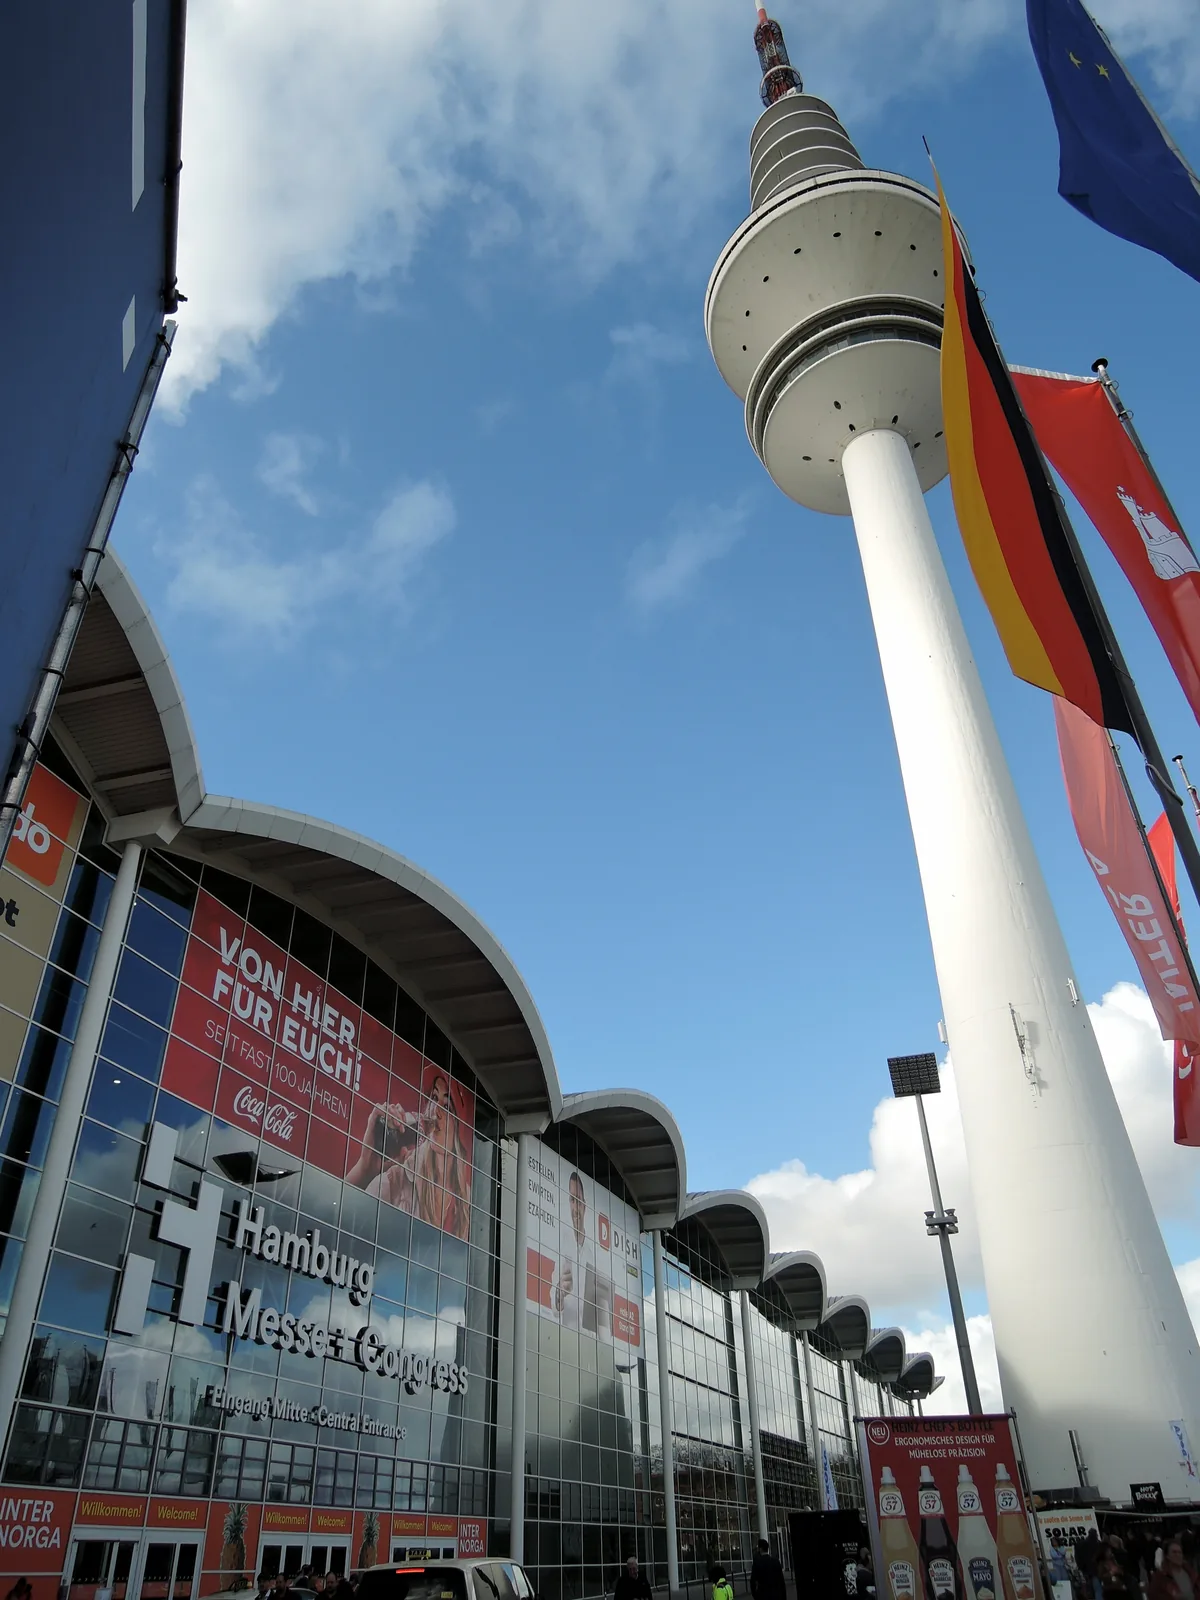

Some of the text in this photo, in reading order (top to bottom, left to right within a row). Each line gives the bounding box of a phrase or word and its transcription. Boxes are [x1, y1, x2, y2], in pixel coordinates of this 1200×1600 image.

[219, 926, 285, 1001] VON
[212, 968, 362, 1092] FÜR EUCH!
[204, 1019, 349, 1120] SEIT FAST 100 JAHREN.
[528, 1156, 556, 1184] ESTELLEN.
[528, 1201, 556, 1228] EZAHLEN.
[234, 1199, 375, 1305] Hamburg
[613, 1230, 638, 1260] DISH
[222, 1280, 329, 1358] Messe
[361, 1325, 469, 1395] Congress
[211, 1384, 270, 1421] Eingang
[272, 1397, 308, 1422] Mitte
[318, 1405, 361, 1432] Central
[362, 1414, 407, 1440] Entrance
[871, 1426, 886, 1436] NEU
[891, 1421, 919, 1433] HEINZ
[958, 1420, 994, 1432] BOTTLE
[894, 1434, 996, 1446] ERGONOMISCHES DESIGN FÜR
[909, 1448, 986, 1459] MÜHELOSE PRÄZISION
[885, 1501, 898, 1511] 57
[924, 1500, 937, 1510] 57
[963, 1498, 975, 1509] 57
[1001, 1497, 1013, 1507] 57
[0, 1497, 54, 1523] INTER
[81, 1501, 198, 1521] Willkommen! Welcome!
[265, 1511, 346, 1528] Willkommen! Welcome!
[394, 1518, 425, 1531] Willkommen!
[0, 1525, 61, 1549] NORGA
[459, 1524, 480, 1537] INTER
[1045, 1526, 1087, 1538] SOLAR
[459, 1539, 484, 1553] NORGA
[973, 1573, 992, 1582] MAYO
